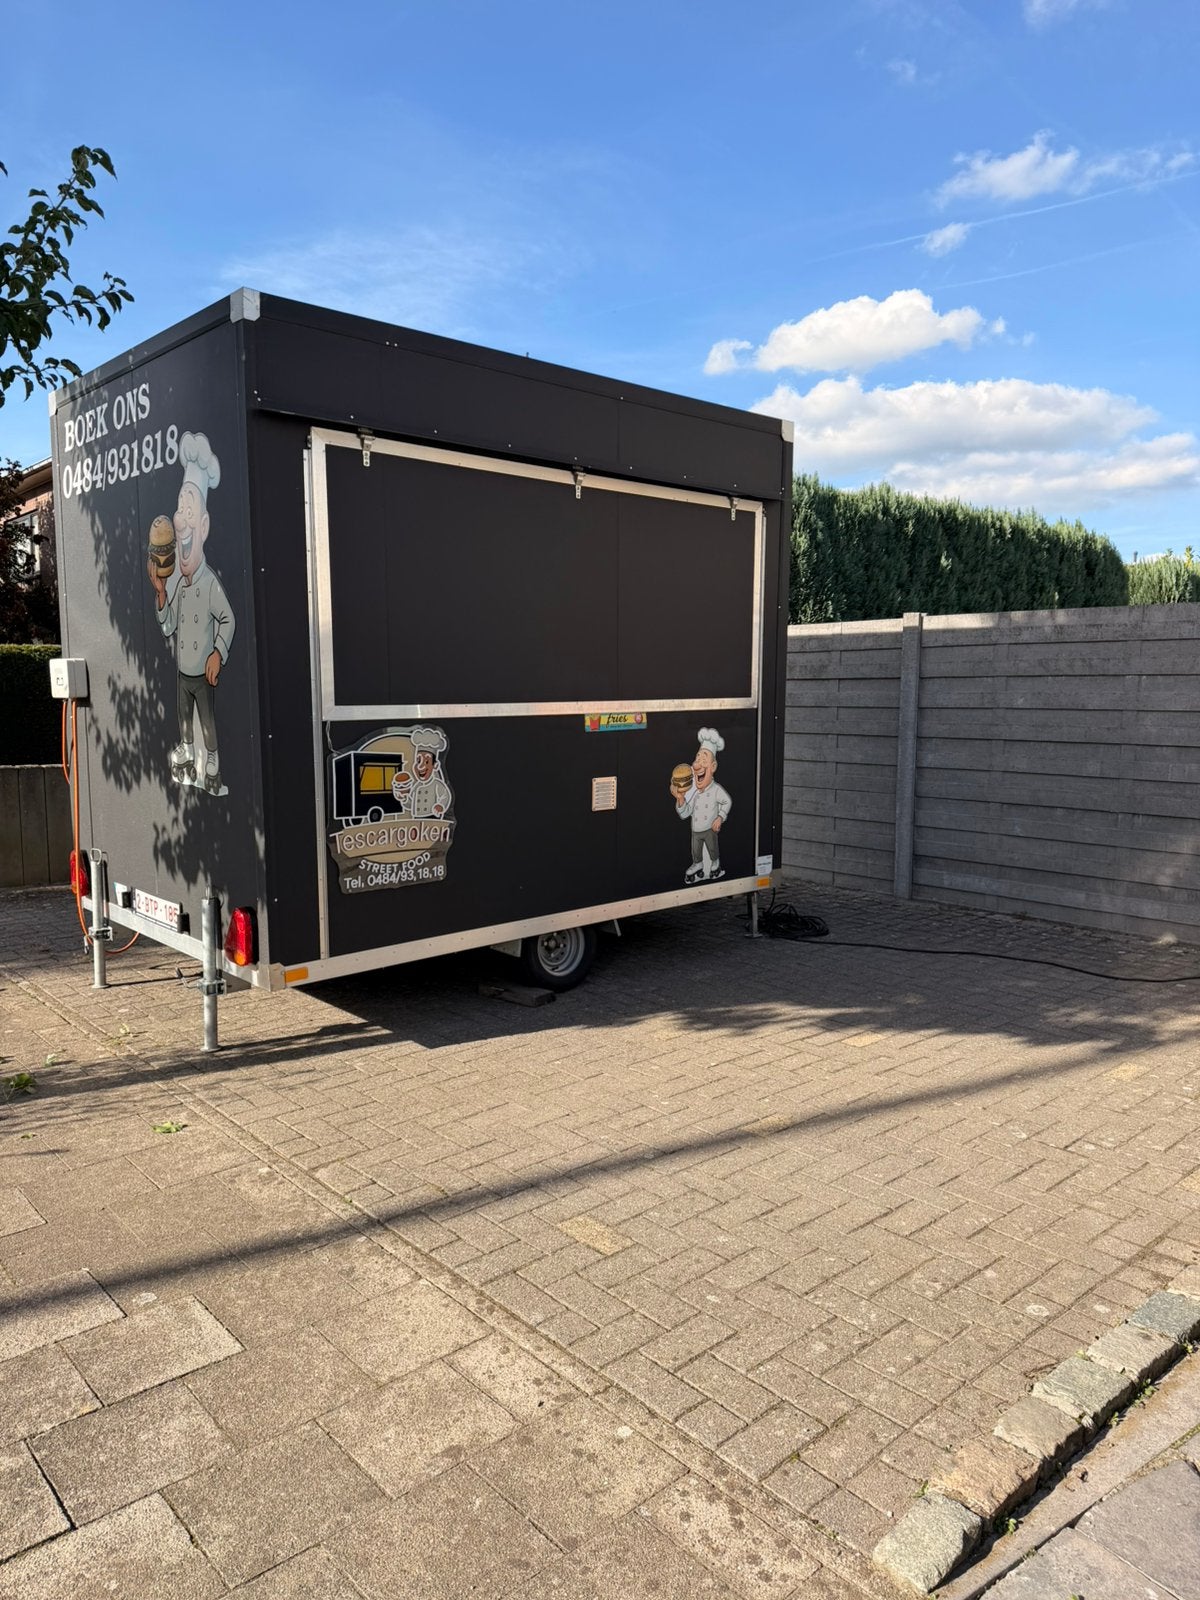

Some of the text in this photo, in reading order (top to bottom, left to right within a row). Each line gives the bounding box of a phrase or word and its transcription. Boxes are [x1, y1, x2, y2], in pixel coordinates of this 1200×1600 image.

[64, 382, 150, 453] BOEK ONS
[63, 425, 179, 498] 0484/931818
[606, 712, 628, 728] fries
[329, 821, 450, 854] Tescargoken
[358, 851, 431, 874] STREET FOOD
